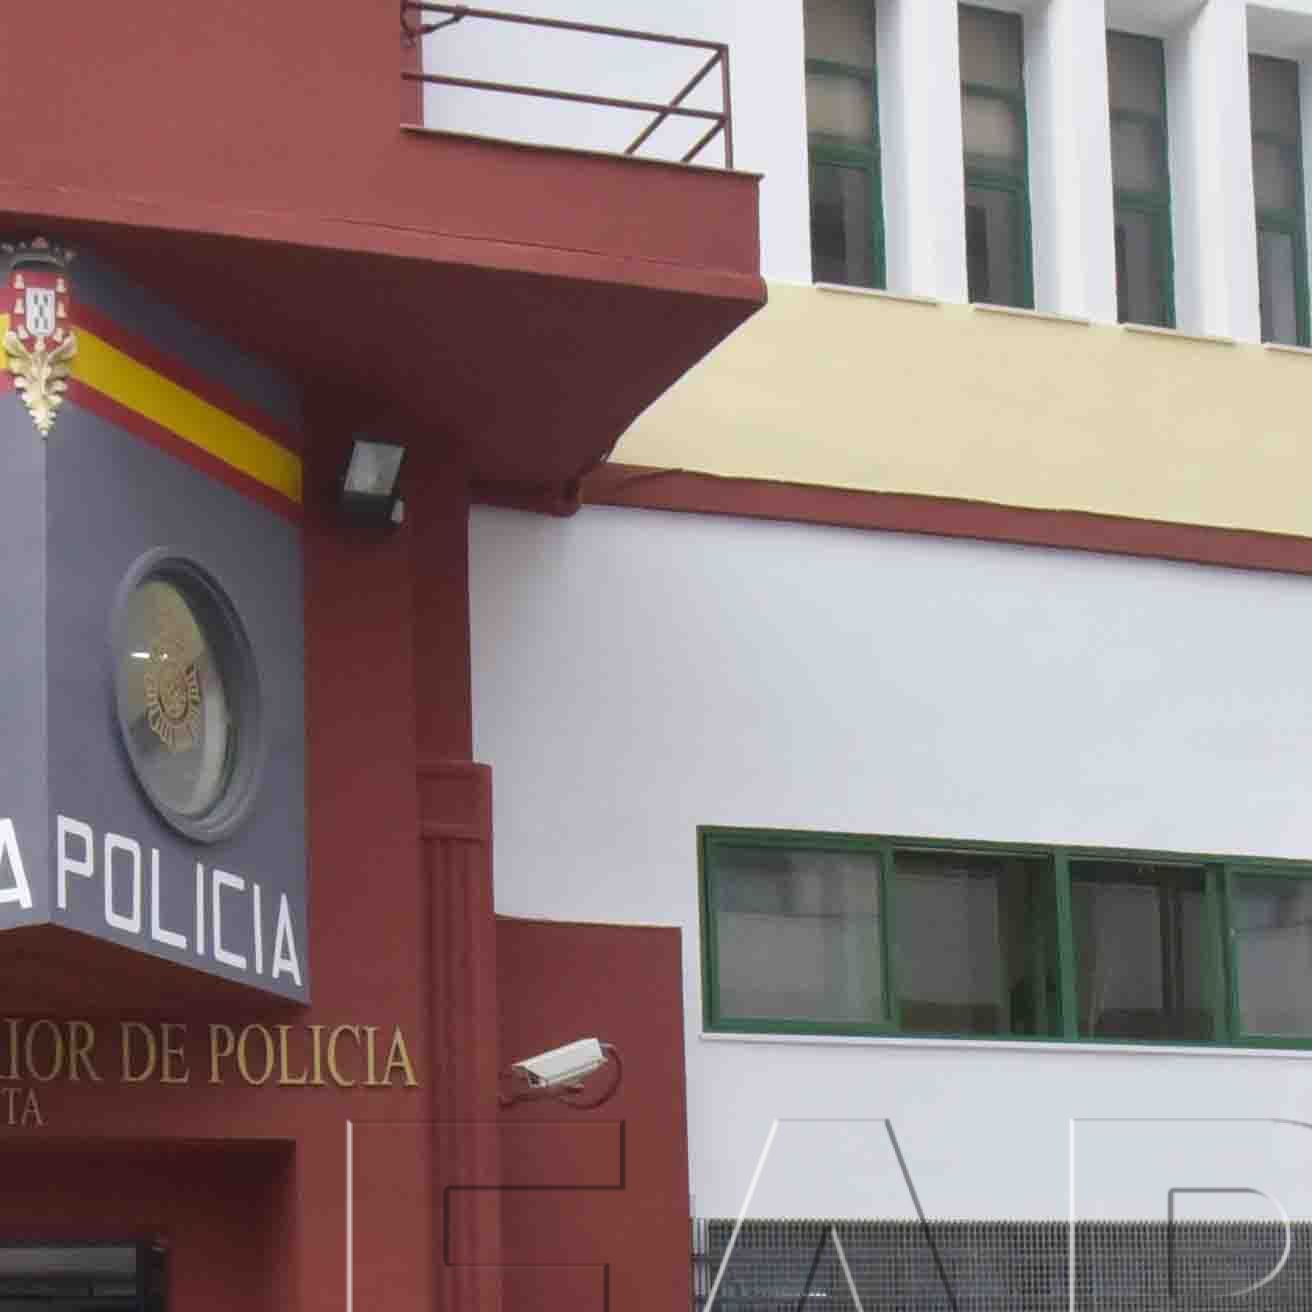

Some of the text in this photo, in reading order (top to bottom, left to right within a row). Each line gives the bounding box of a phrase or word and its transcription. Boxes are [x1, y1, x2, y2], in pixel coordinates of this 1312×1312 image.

[57, 814, 302, 986] POLICIA
[120, 1021, 189, 1084] DE
[208, 1023, 419, 1087] POLICIA
